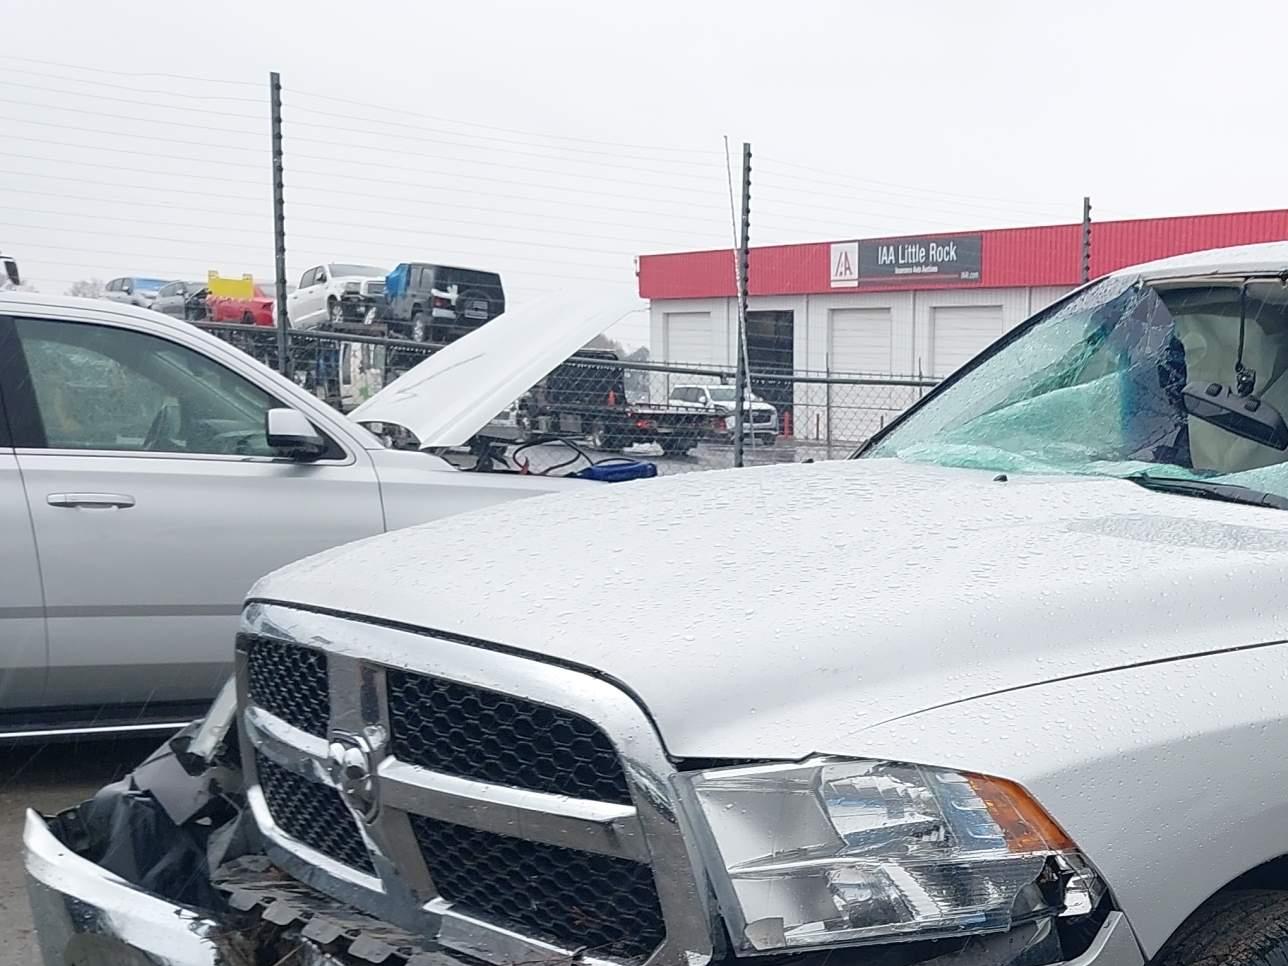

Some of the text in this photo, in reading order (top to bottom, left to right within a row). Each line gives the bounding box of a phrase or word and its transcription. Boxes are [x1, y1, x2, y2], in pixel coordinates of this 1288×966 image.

[878, 241, 957, 265] IAA Little Rock
